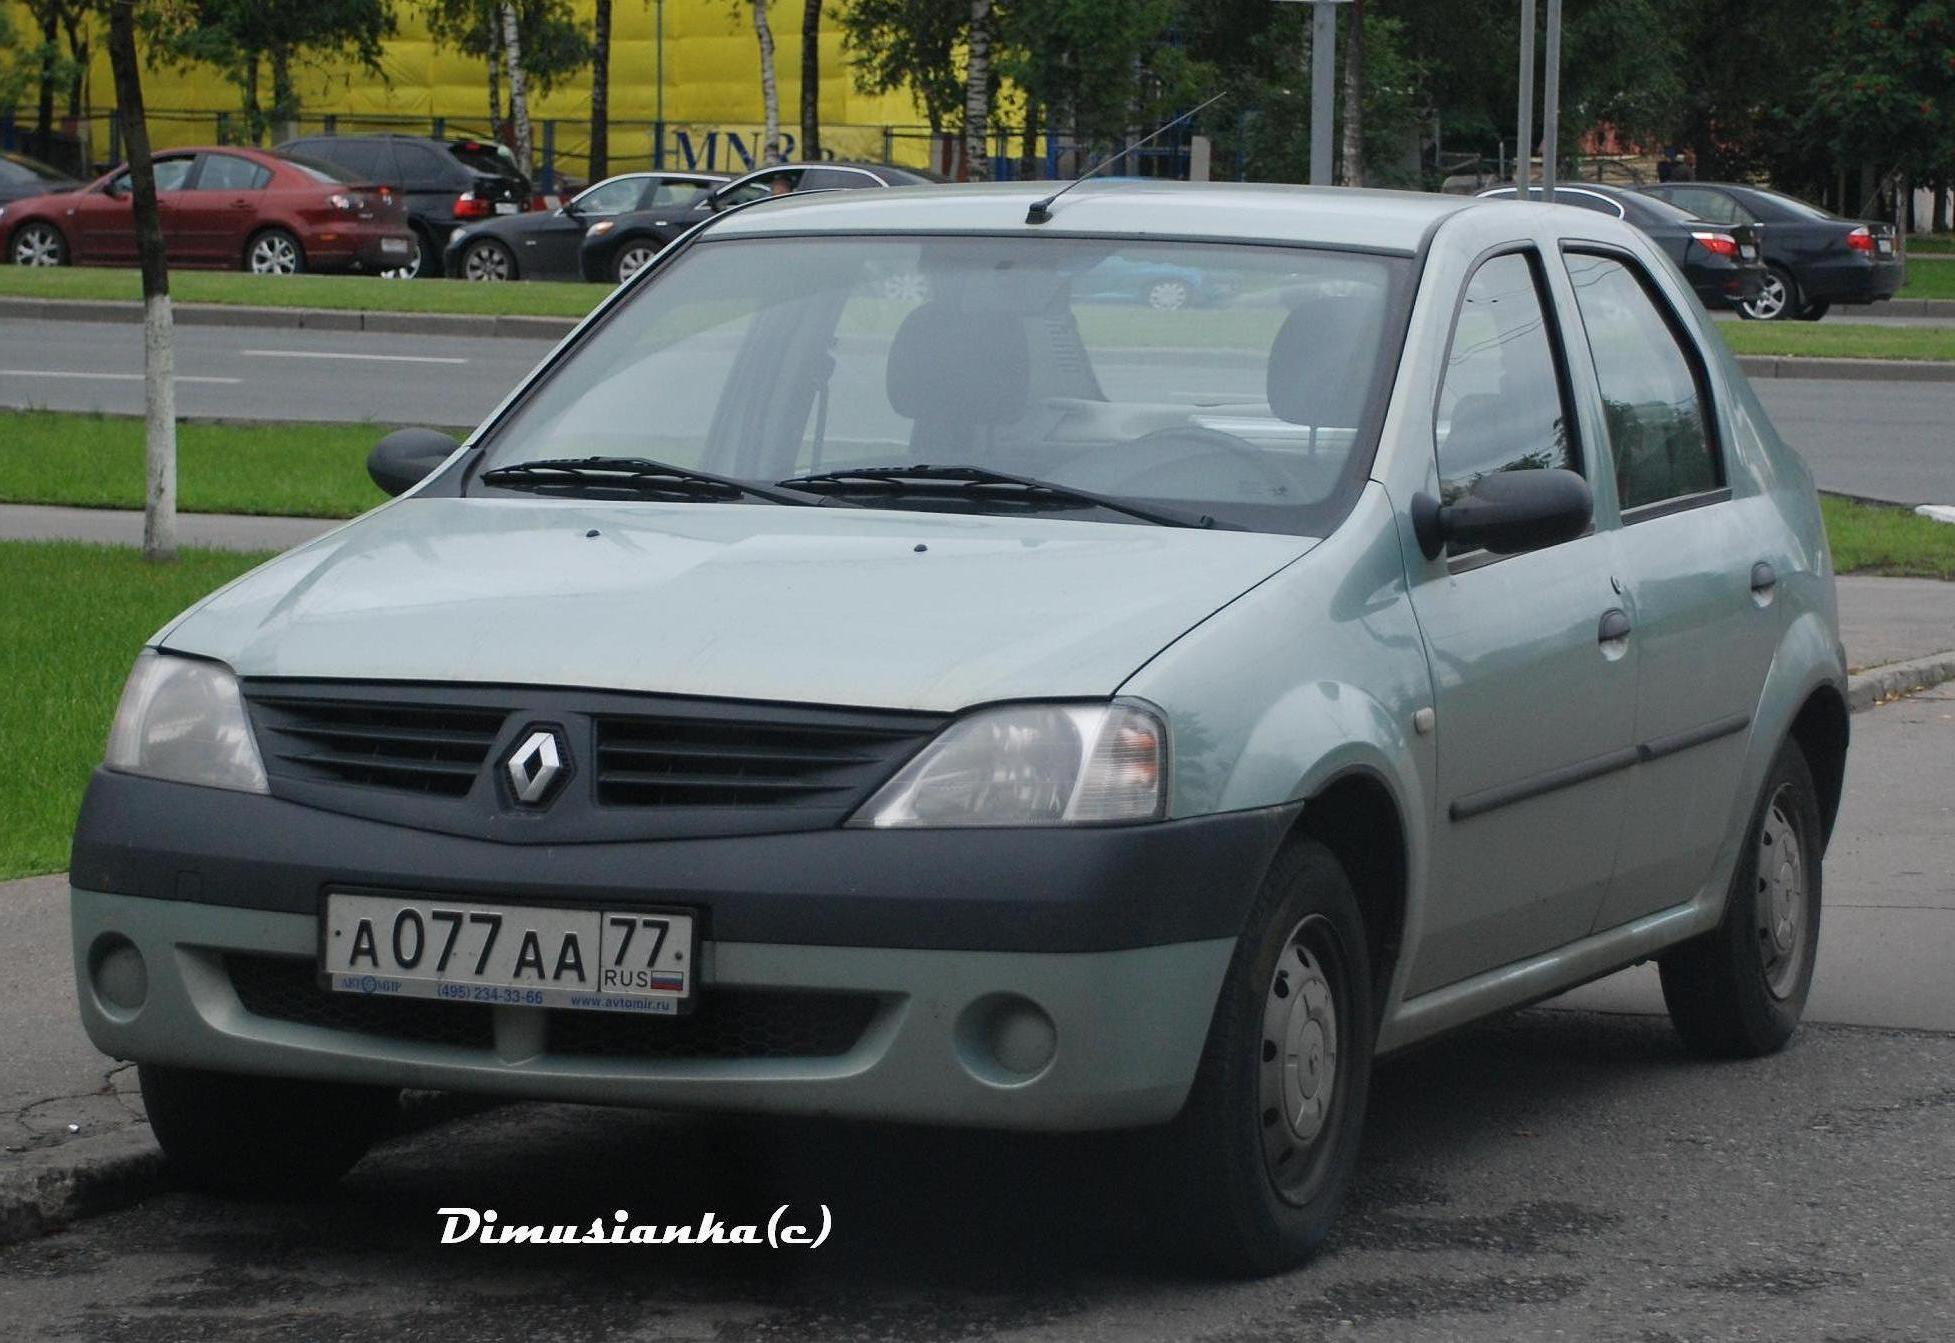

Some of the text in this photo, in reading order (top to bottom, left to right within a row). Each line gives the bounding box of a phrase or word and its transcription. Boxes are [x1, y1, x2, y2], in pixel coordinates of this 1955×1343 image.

[609, 917, 670, 967] 77
[604, 969, 648, 988] RUS
[437, 985, 544, 1005] (495) 234-33-66
[571, 993, 670, 1011] www.avtomir.ru
